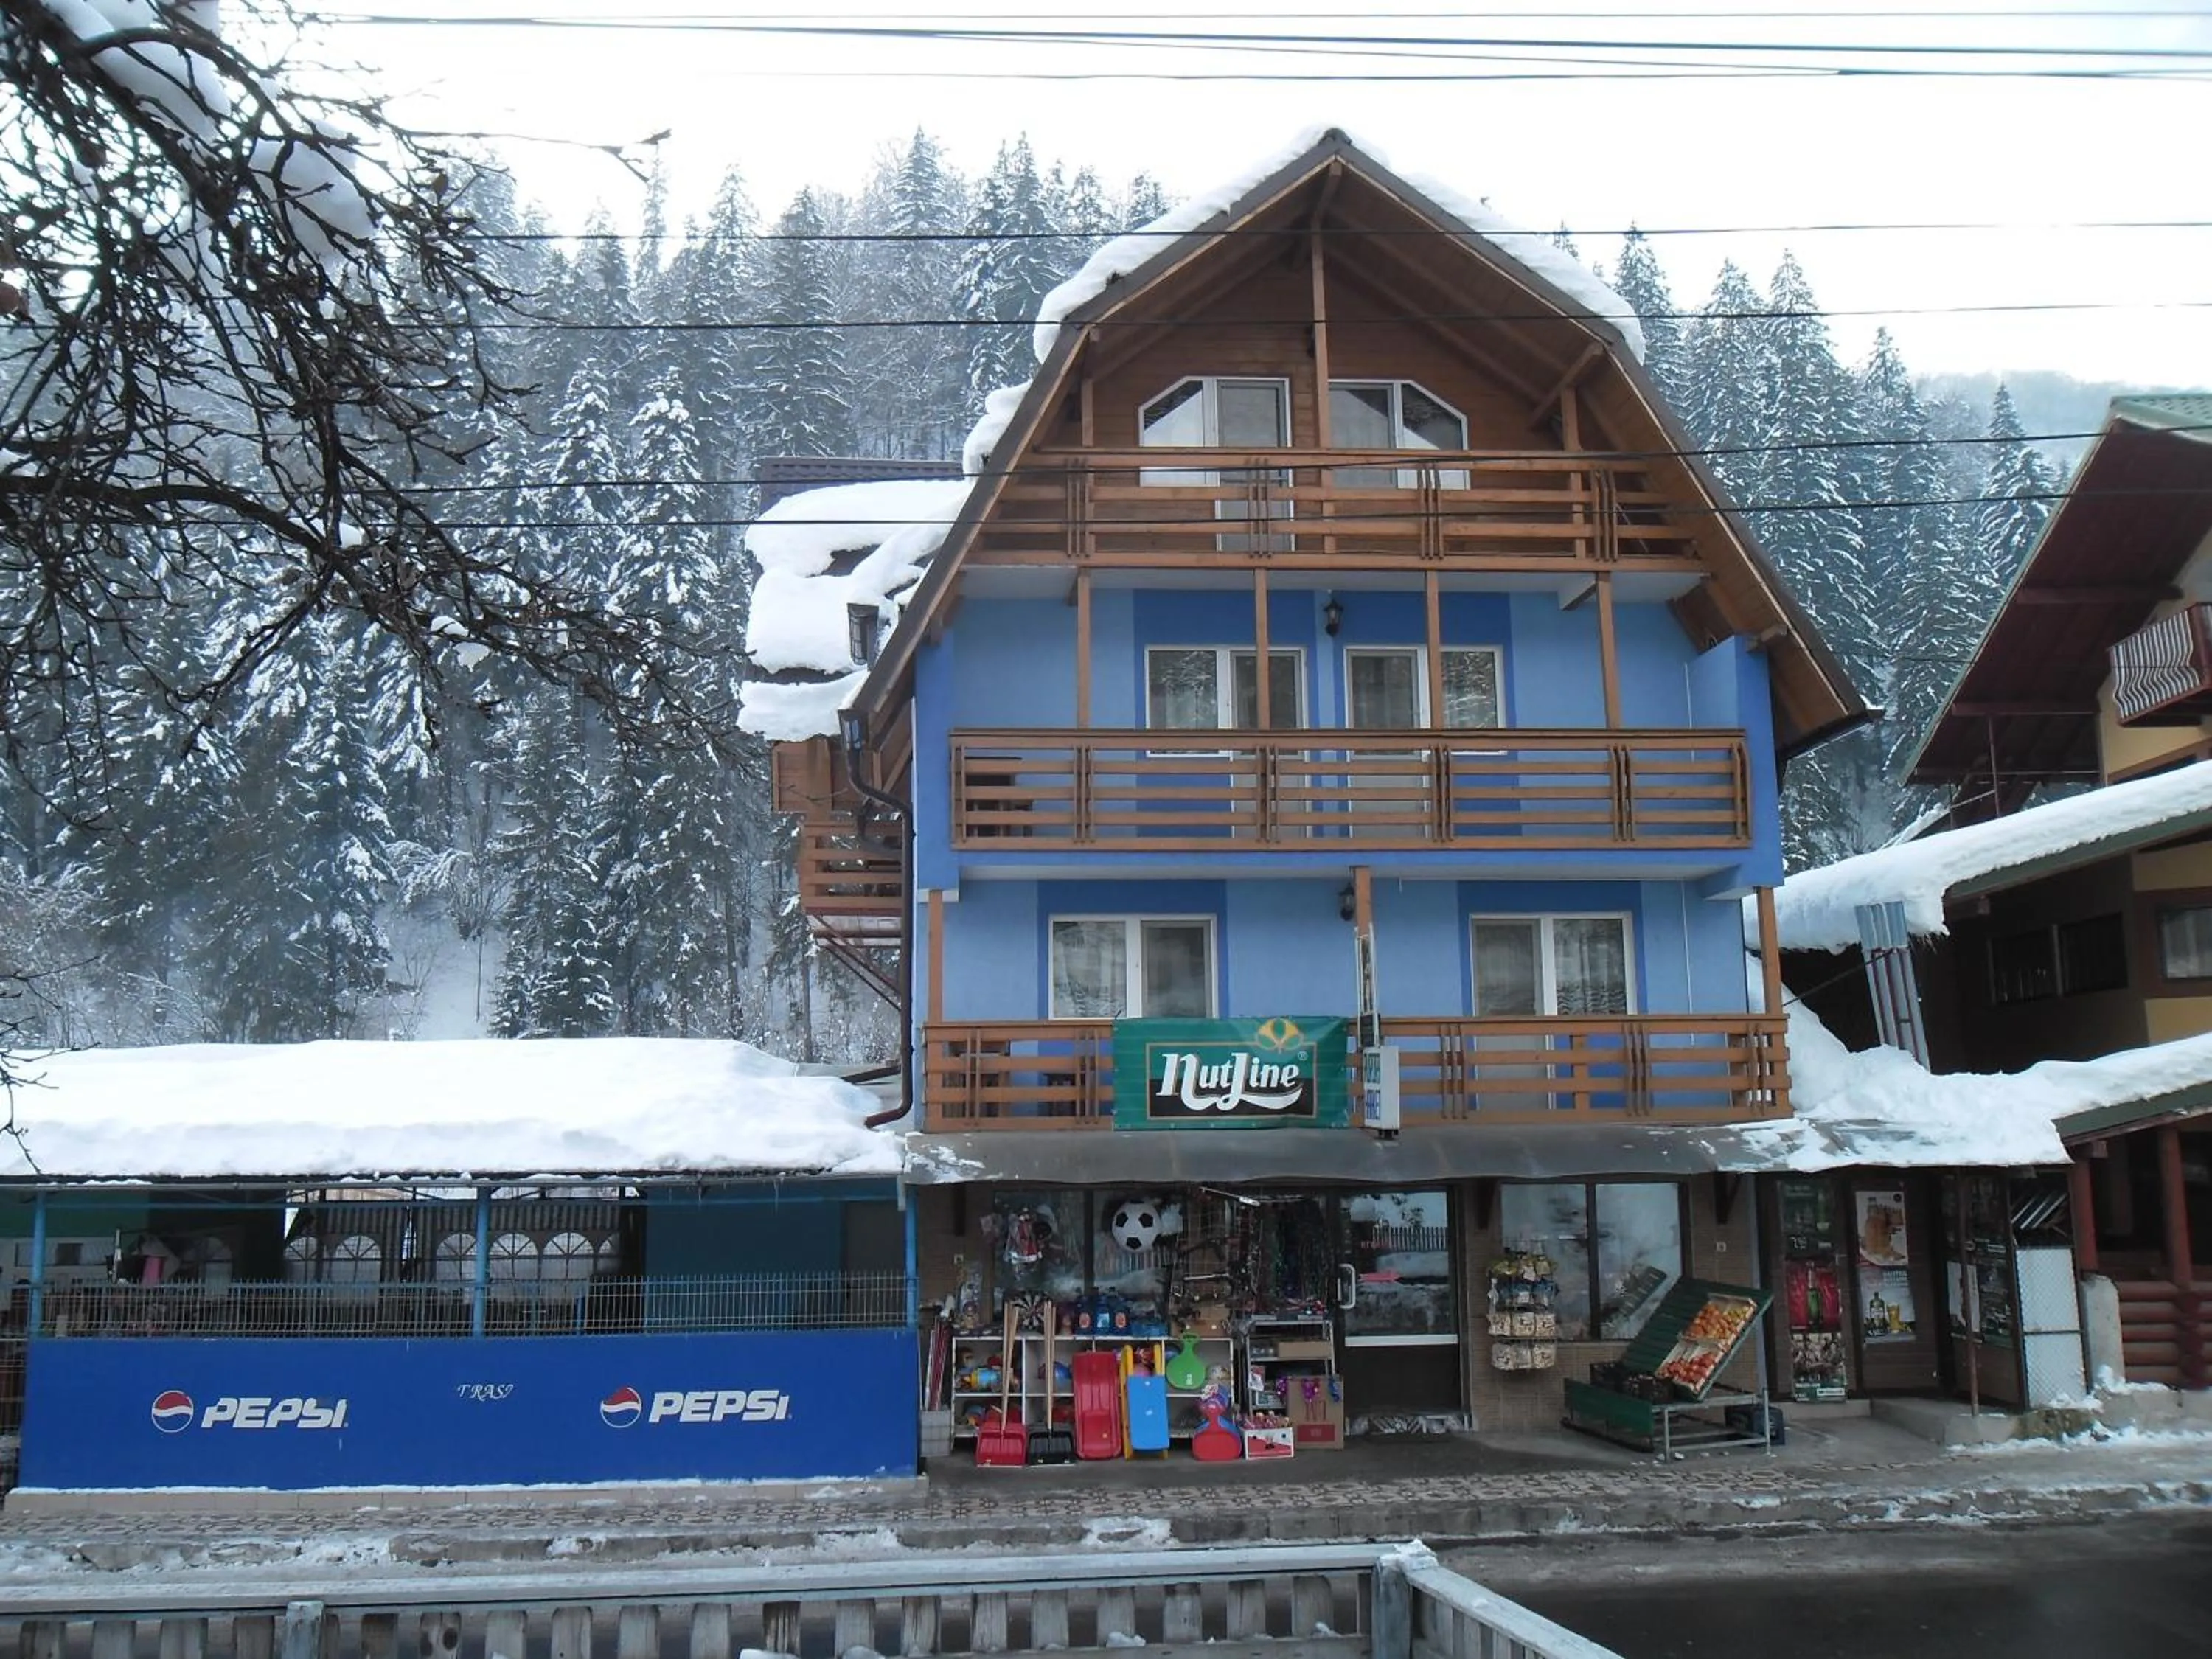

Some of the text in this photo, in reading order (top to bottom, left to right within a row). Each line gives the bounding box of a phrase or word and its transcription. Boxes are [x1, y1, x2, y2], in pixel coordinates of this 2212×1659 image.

[1155, 1051, 1303, 1111] NutLine
[200, 1397, 347, 1428] PEPSI
[647, 1389, 790, 1423] PEPSI
